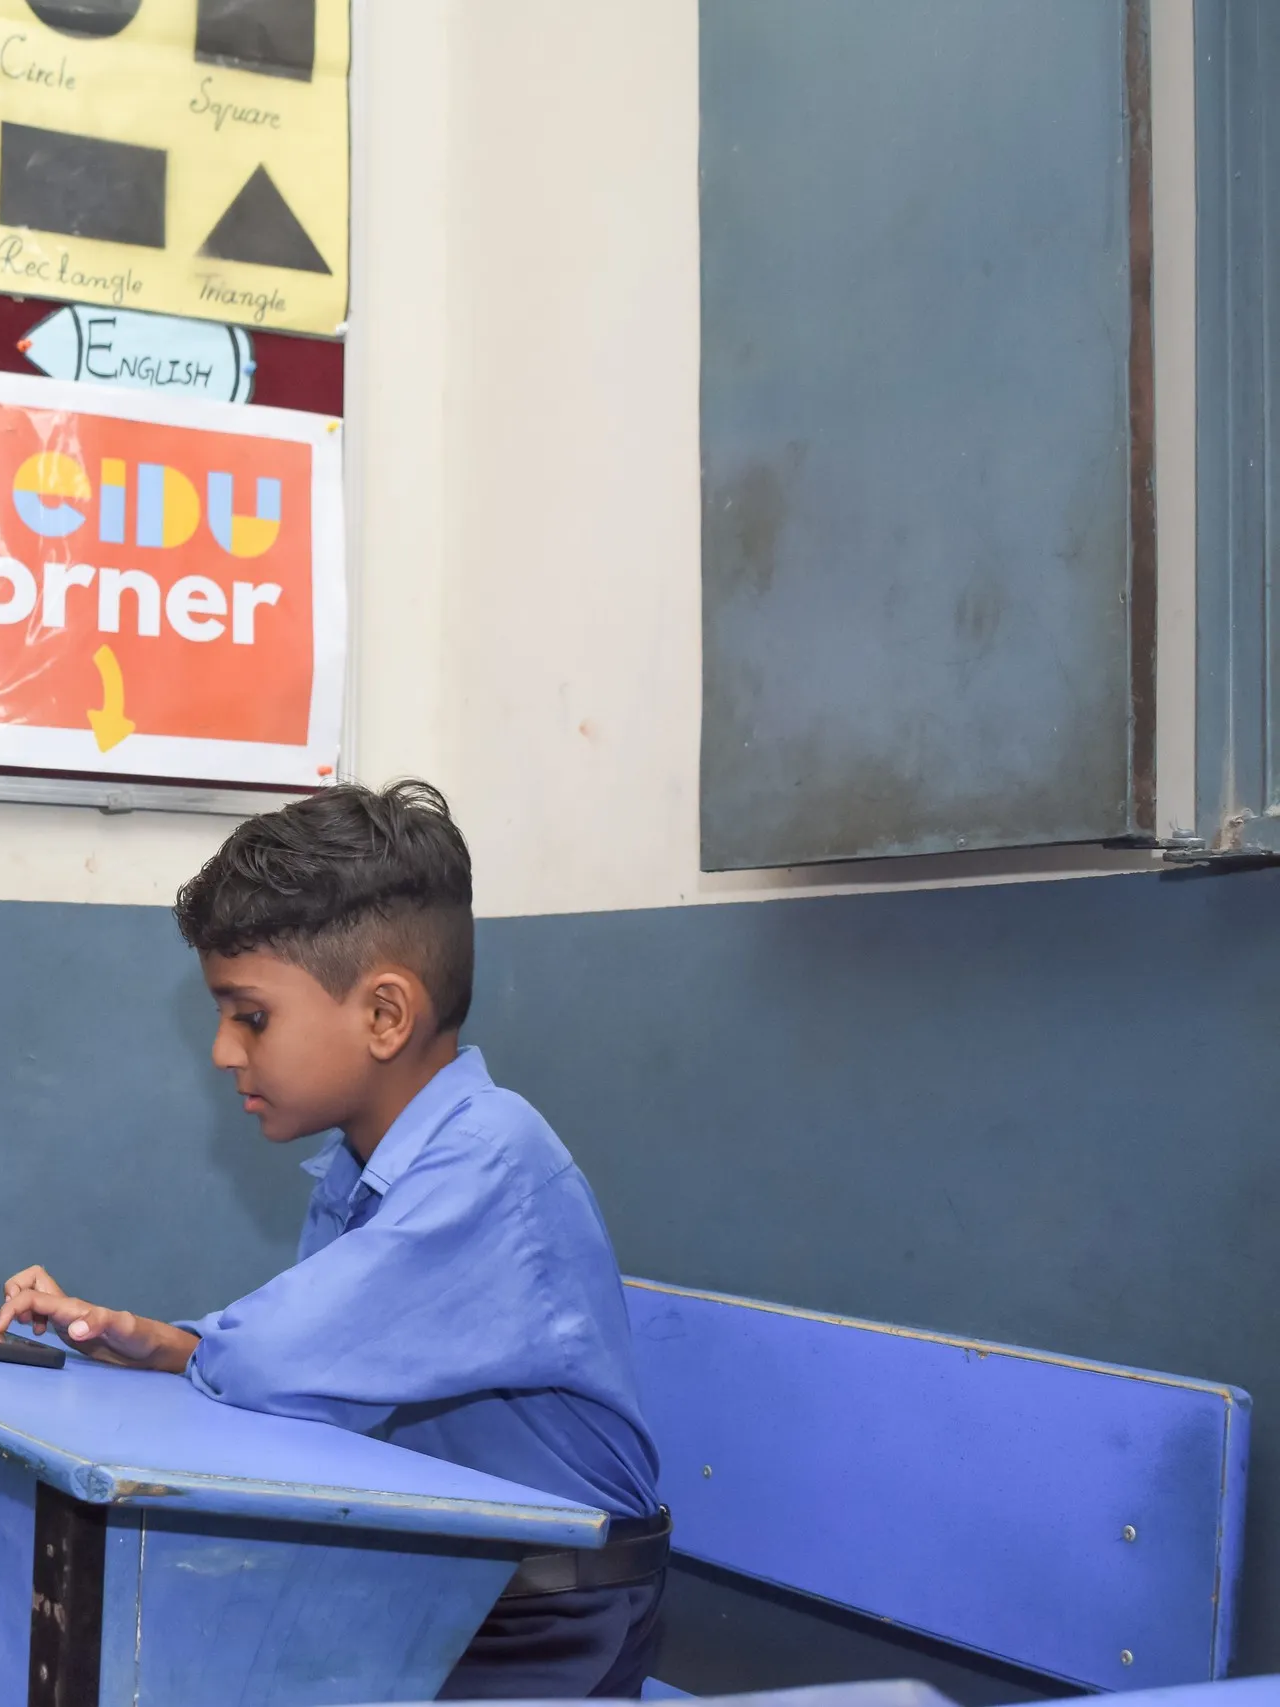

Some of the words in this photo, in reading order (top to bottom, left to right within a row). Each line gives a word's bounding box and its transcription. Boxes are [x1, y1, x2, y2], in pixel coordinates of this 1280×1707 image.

[0, 33, 77, 91] Circle
[189, 77, 281, 130] Square
[194, 272, 287, 323] Triangle
[86, 318, 214, 388] ENGLISH
